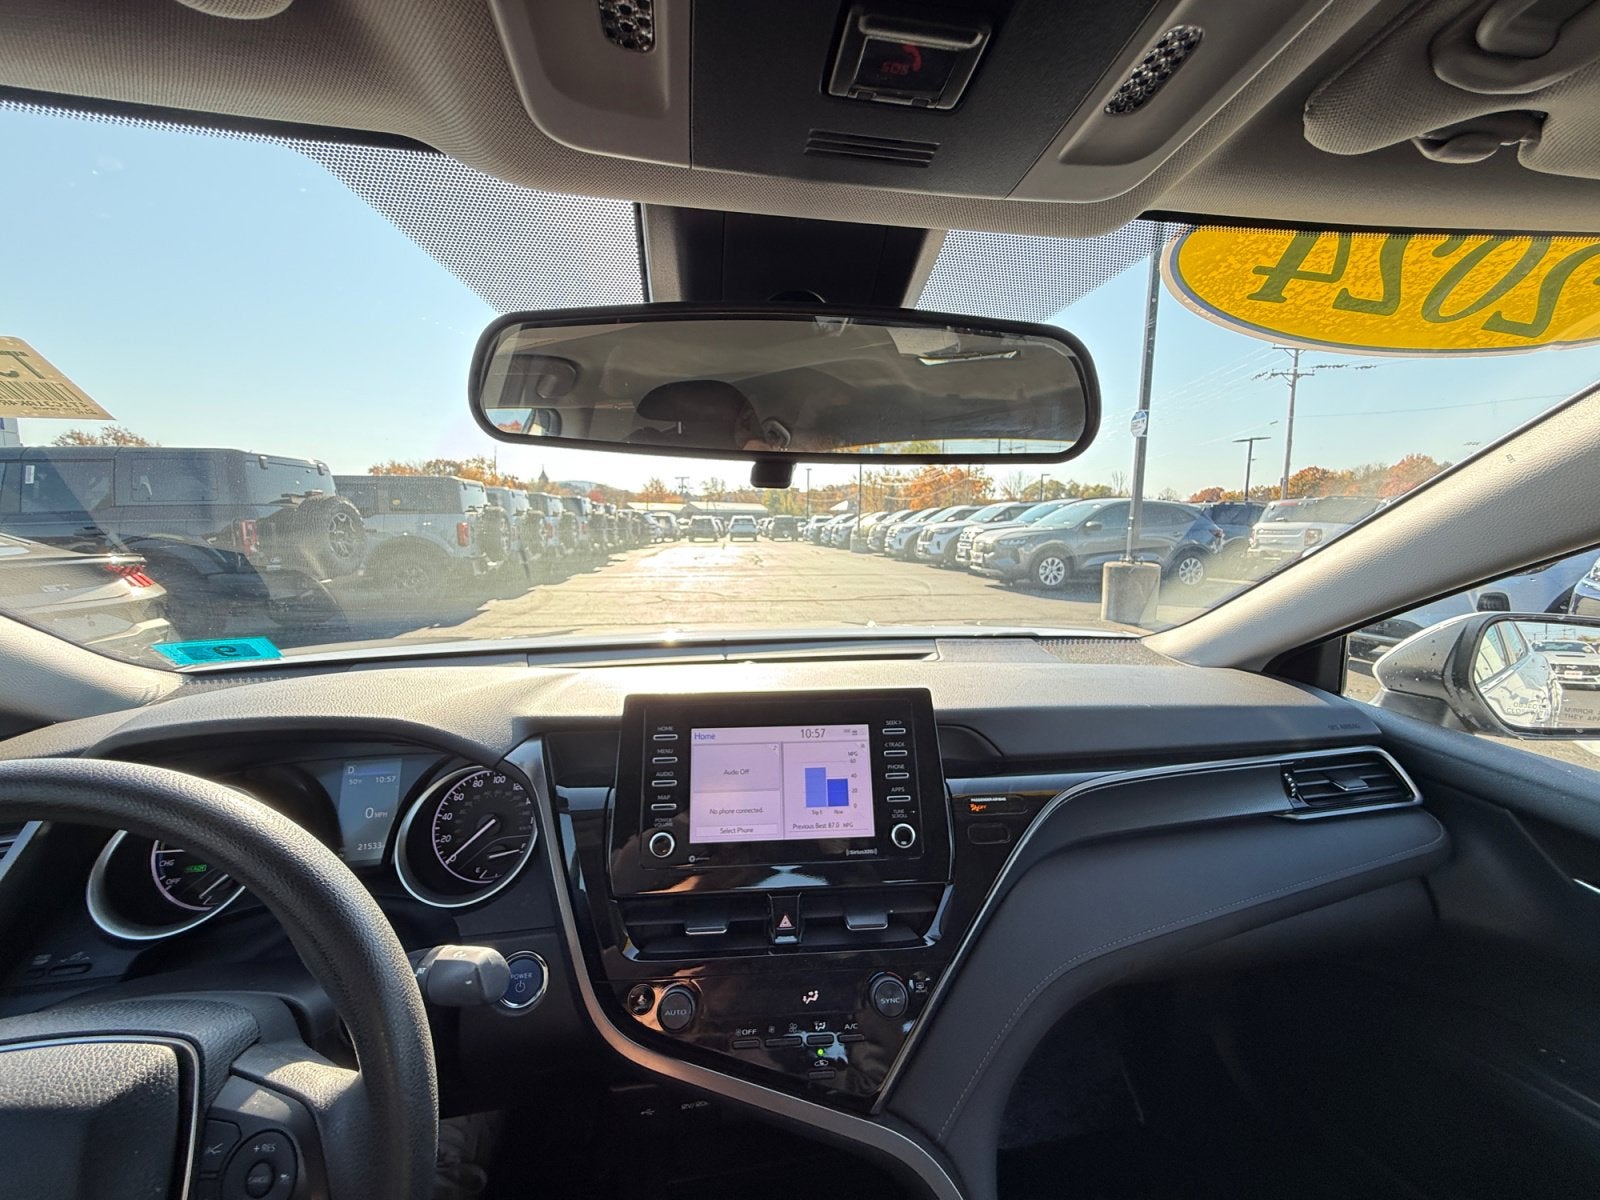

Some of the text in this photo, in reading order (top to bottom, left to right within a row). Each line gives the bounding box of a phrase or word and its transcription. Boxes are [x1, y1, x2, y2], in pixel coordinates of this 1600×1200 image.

[881, 62, 910, 75] SOS
[800, 728, 825, 739] 10:57
[375, 775, 396, 784] 10:57
[472, 779, 484, 788] 80
[493, 775, 506, 784] 100
[453, 793, 464, 801] 60
[365, 807, 374, 819] 0
[441, 812, 453, 821] 40
[719, 808, 735, 816] phone
[440, 834, 452, 843] 20
[357, 841, 382, 851] 21533
[159, 858, 175, 867] CHG
[510, 972, 533, 980] POWER
[880, 996, 900, 1005] SYNC
[664, 1008, 687, 1016] AUTO
[741, 1028, 757, 1036] OFF
